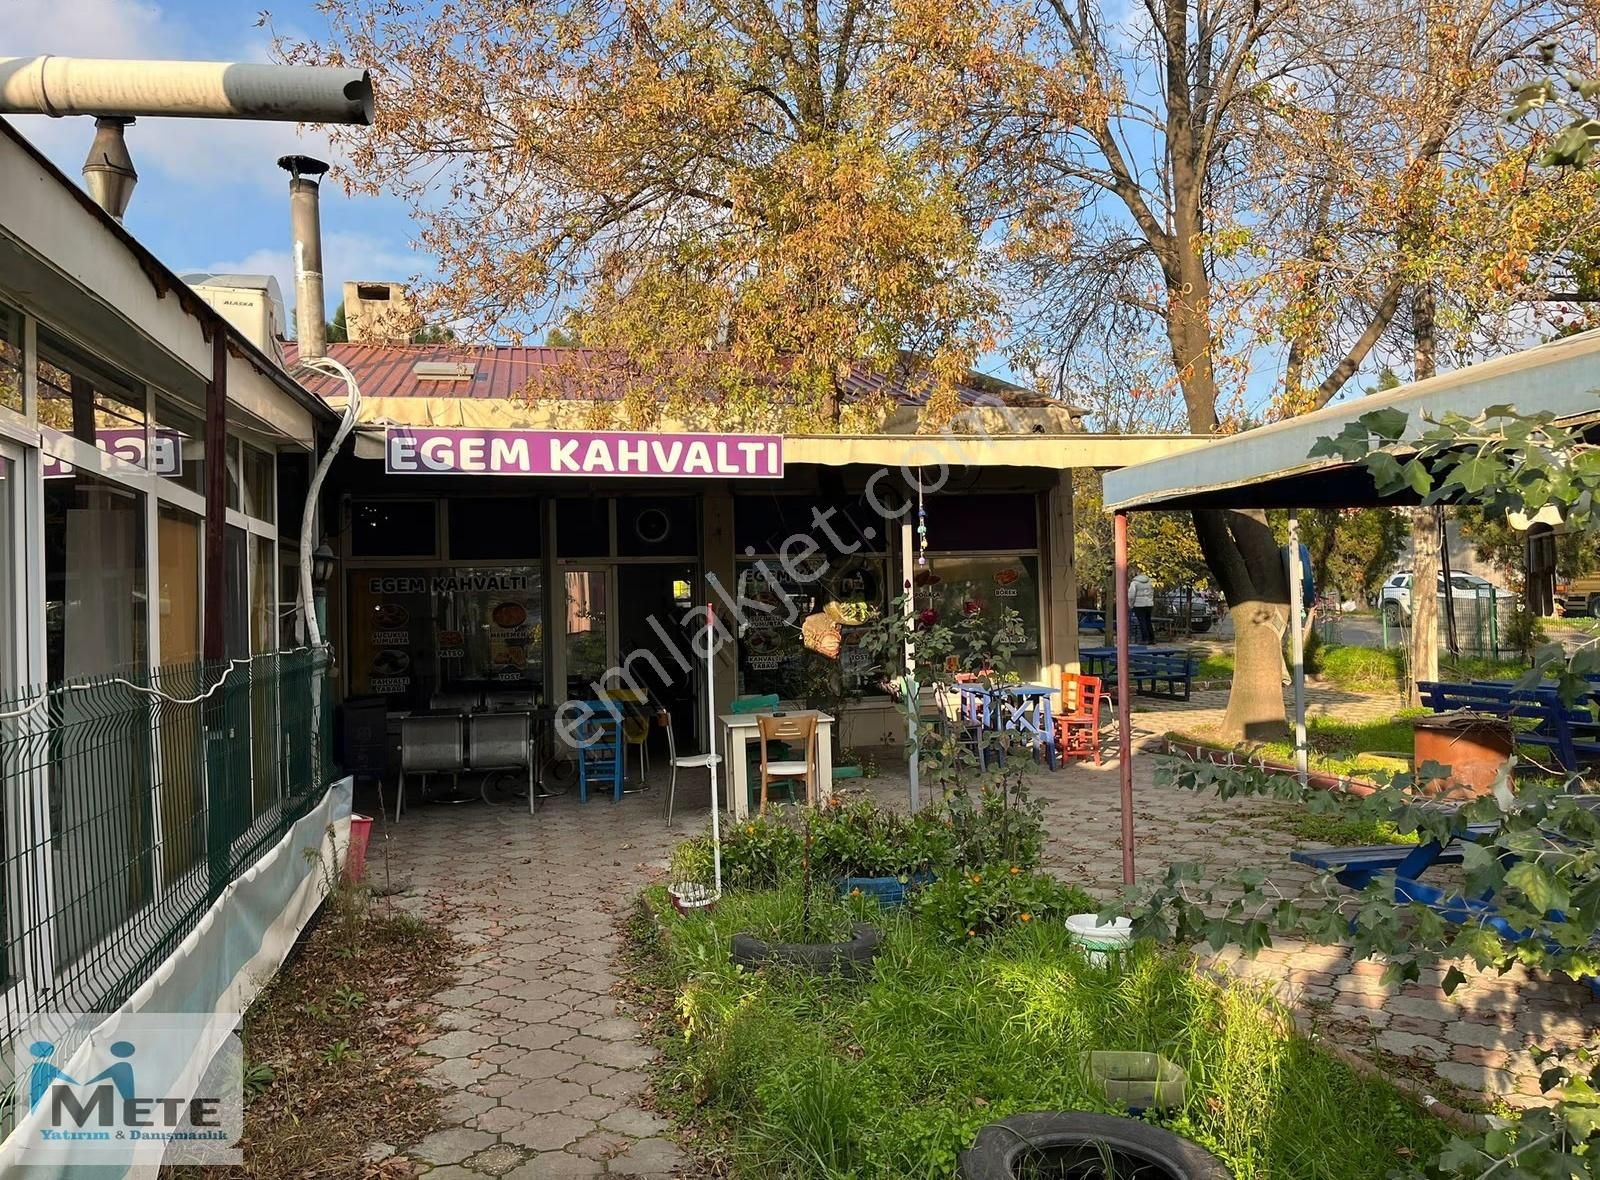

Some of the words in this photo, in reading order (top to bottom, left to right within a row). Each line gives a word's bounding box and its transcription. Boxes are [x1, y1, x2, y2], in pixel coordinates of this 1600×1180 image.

[390, 436, 531, 472] EGEM
[550, 438, 778, 474] KAHVALTI
[370, 579, 425, 591] EGEM
[433, 577, 528, 590] KAHVALTI
